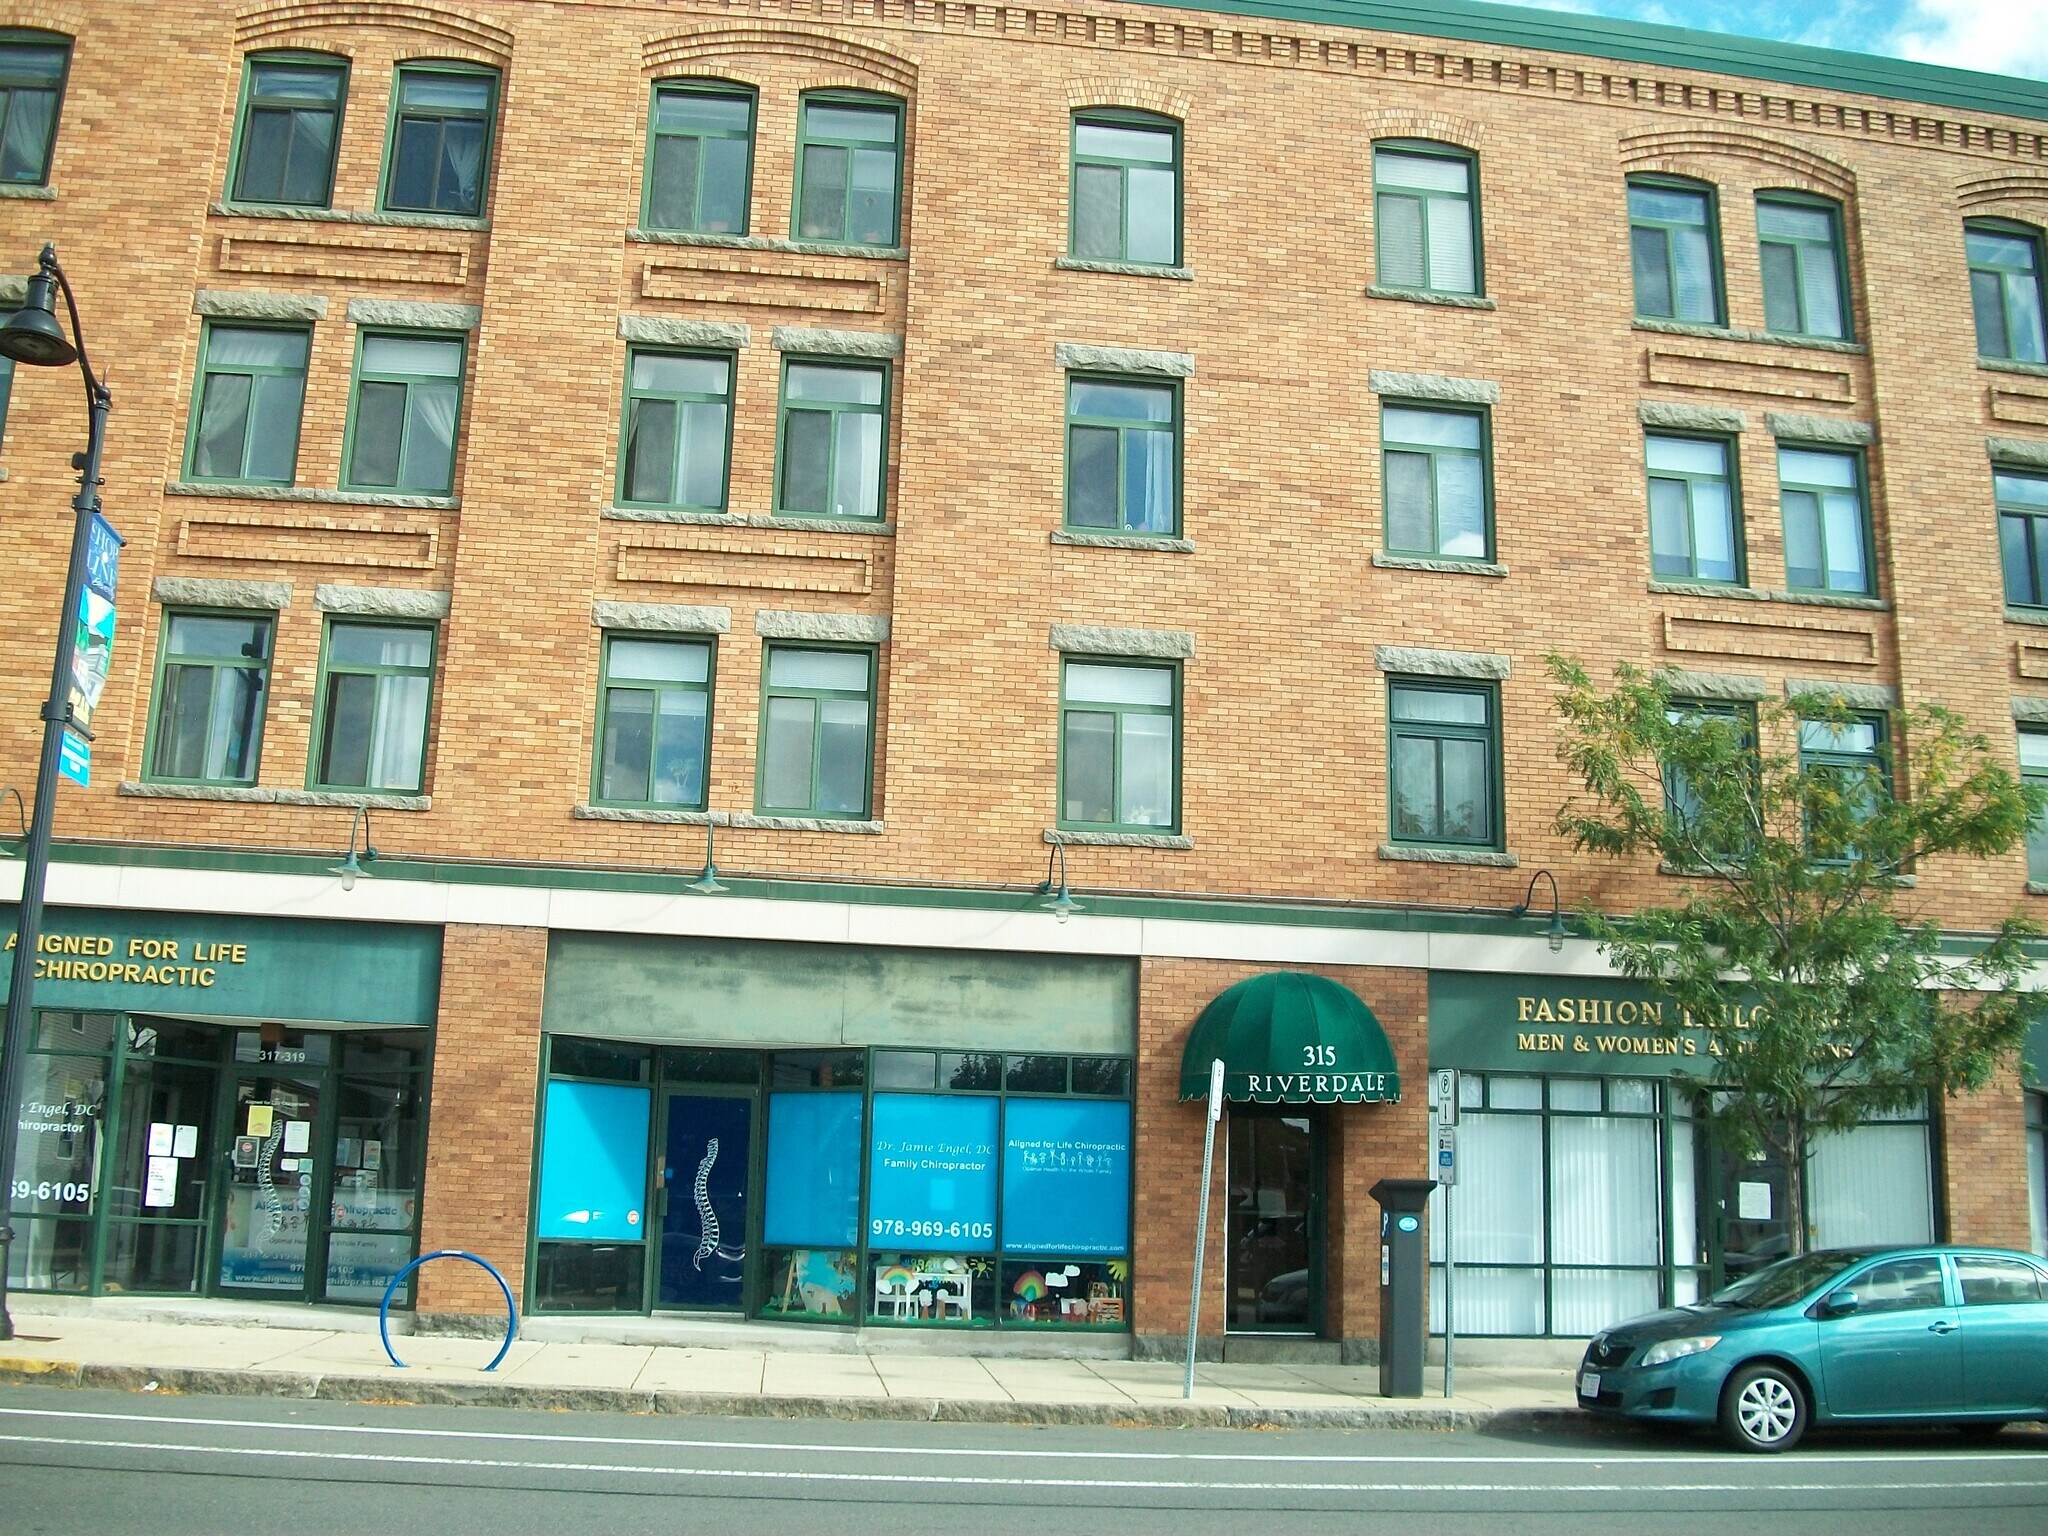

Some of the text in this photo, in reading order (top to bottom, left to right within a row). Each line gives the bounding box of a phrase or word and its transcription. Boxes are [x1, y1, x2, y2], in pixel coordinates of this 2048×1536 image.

[91, 522, 118, 560] SHOP
[4, 933, 247, 963] AIGNED FOR LIFE
[34, 958, 216, 987] CHIROPRACTIC
[1517, 997, 1663, 1026] FASHION
[1518, 1033, 1565, 1051] MEN
[1572, 1034, 1591, 1052] &
[1595, 1036, 1697, 1056] WOMEN'S
[259, 1050, 306, 1063] 317-319
[1302, 1045, 1337, 1067] 315
[1248, 1074, 1386, 1093] RIVERDALE
[28, 1102, 71, 1118] Engel,
[74, 1104, 97, 1116] DC
[18, 1120, 85, 1133] hiropractor
[876, 1141, 995, 1157] Dr. Jamie Engel, DC
[1008, 1139, 1126, 1152] Aligned for Life Chiropractic
[884, 1158, 986, 1172] Family Chiropractor
[872, 1219, 993, 1239] 978-969-6105
